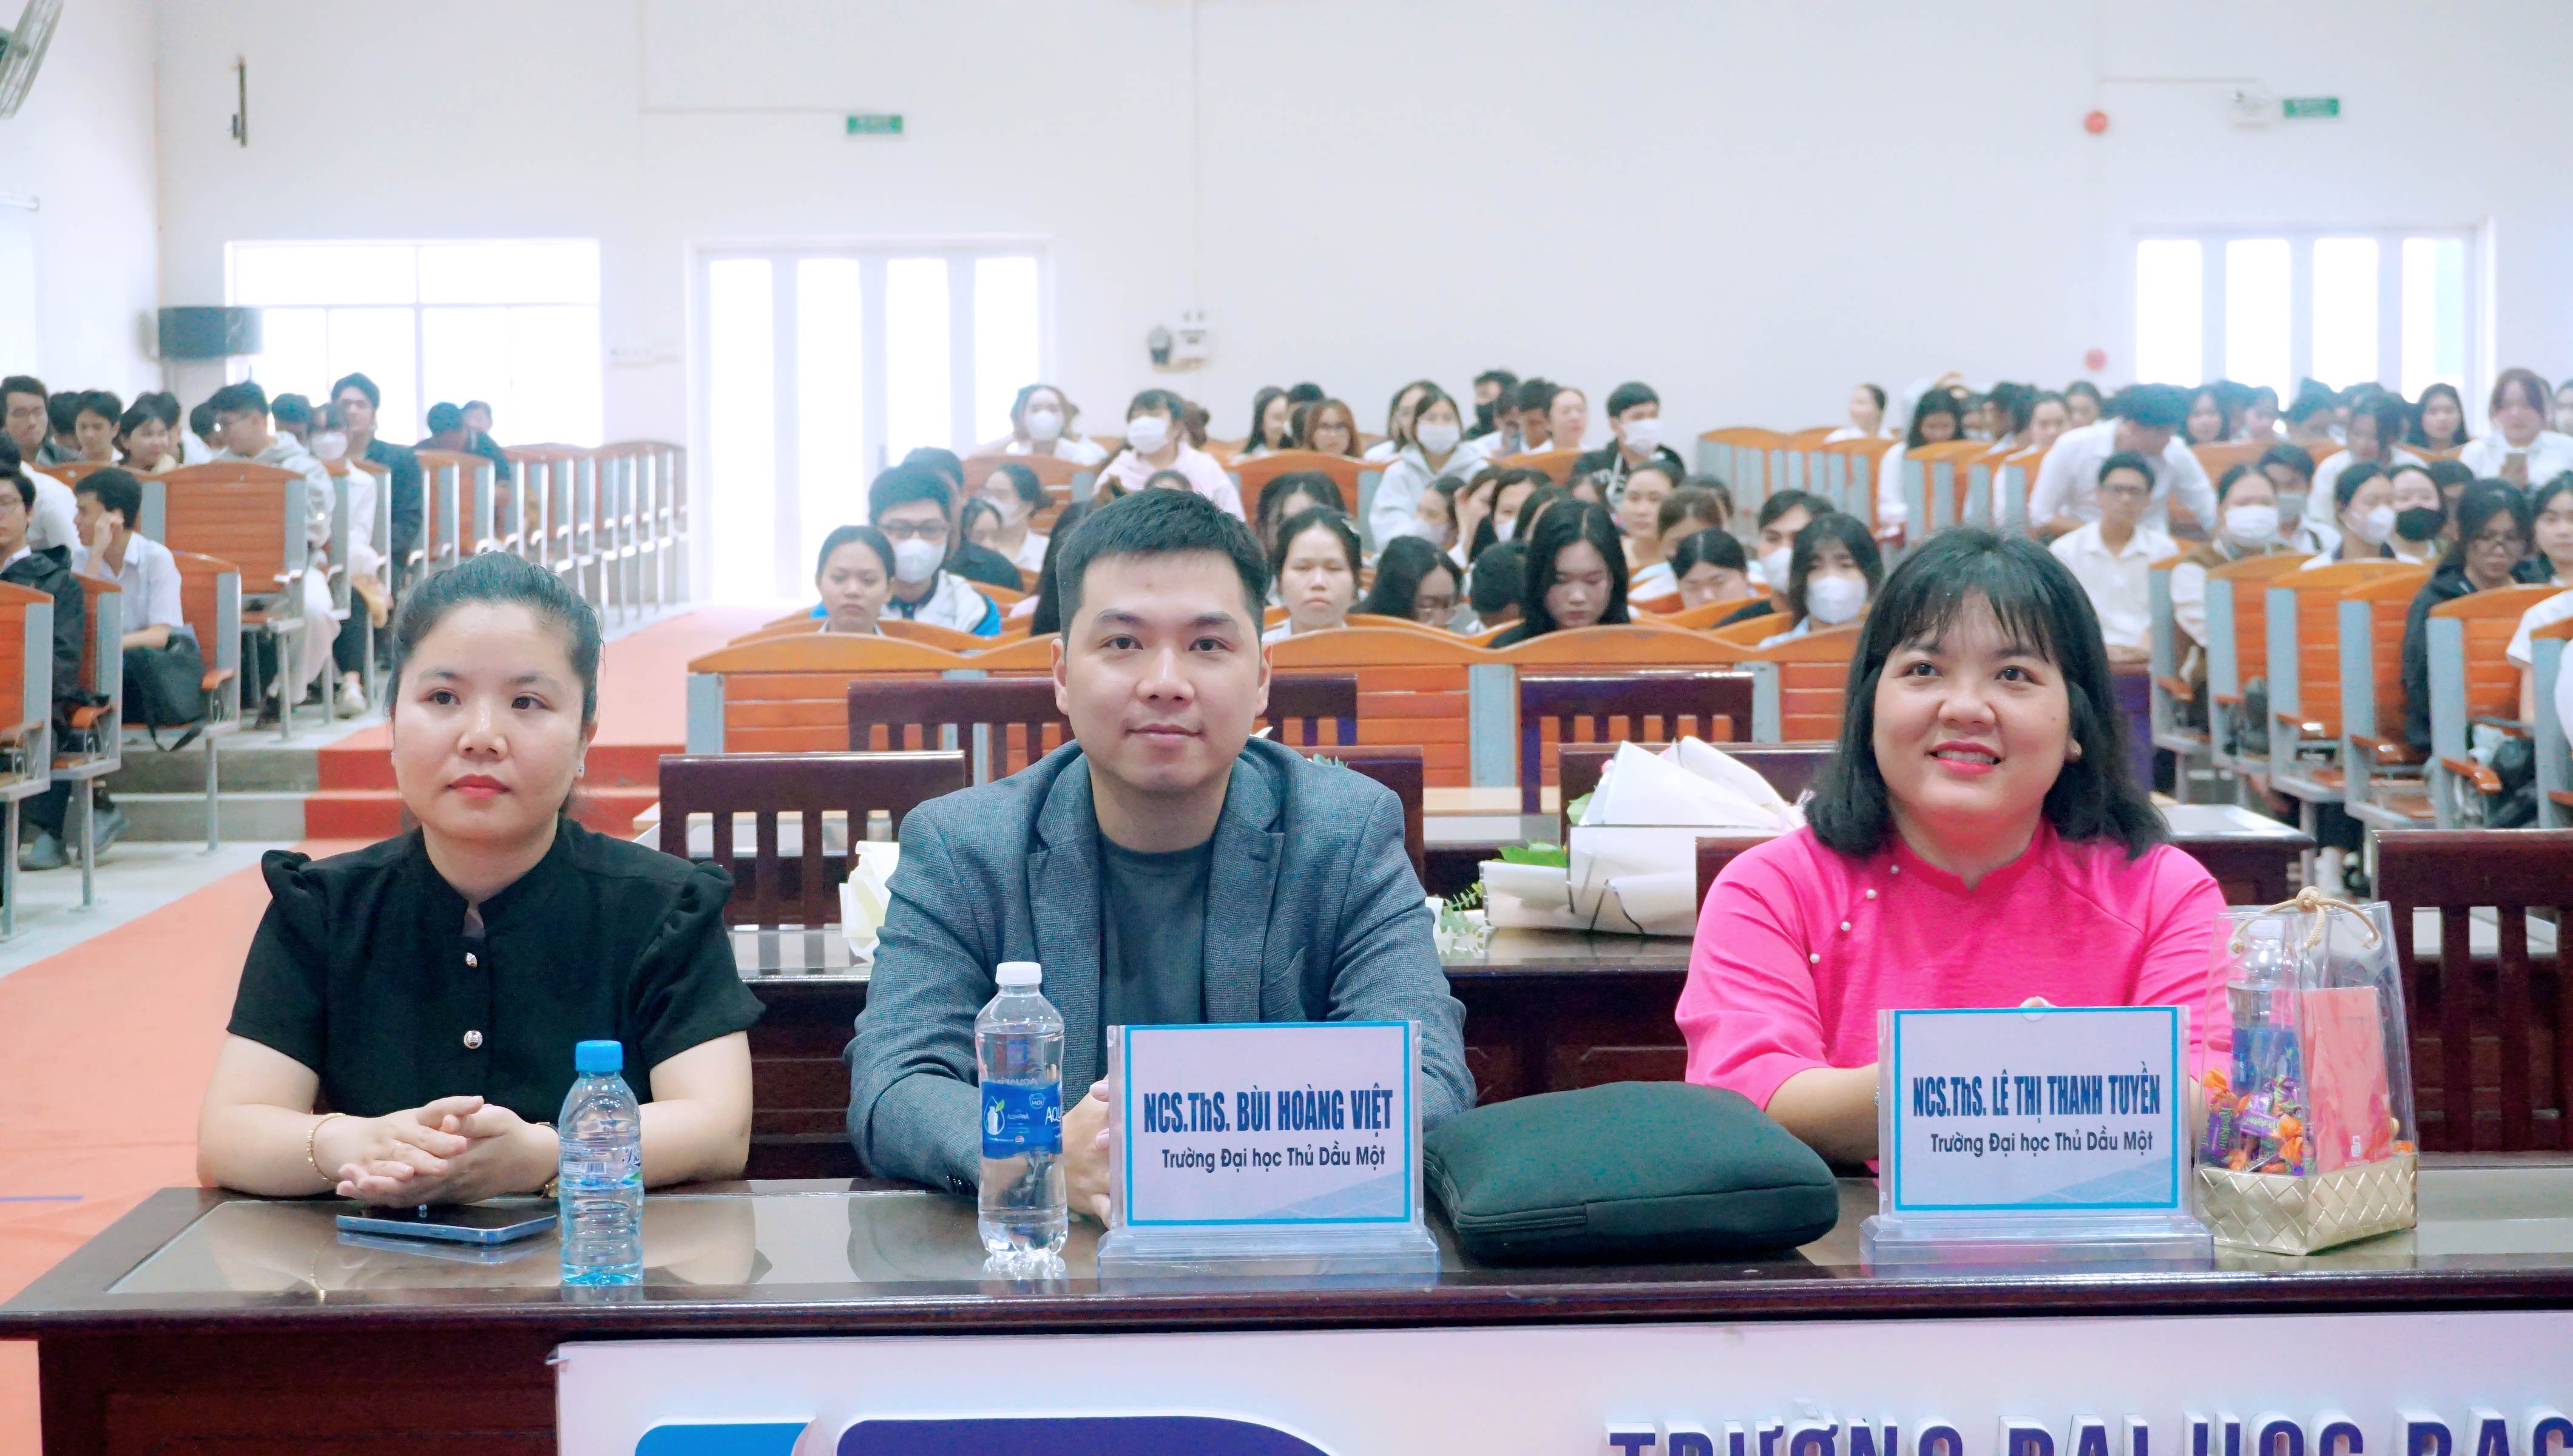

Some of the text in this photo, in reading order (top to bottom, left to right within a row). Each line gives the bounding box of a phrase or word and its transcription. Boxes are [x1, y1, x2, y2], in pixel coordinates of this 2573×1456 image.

[1143, 1082, 1393, 1138] NCS.ThS. BÙI HOÀNG VIỆT
[1913, 1061, 2161, 1124] NCS.ThS. LÊ THỊ THANH TUYỀN
[1161, 1141, 1386, 1173] Trường Đại học Thủ Dầu Một
[1930, 1125, 2154, 1158] Trường Đại học Thủ Dầu Một
